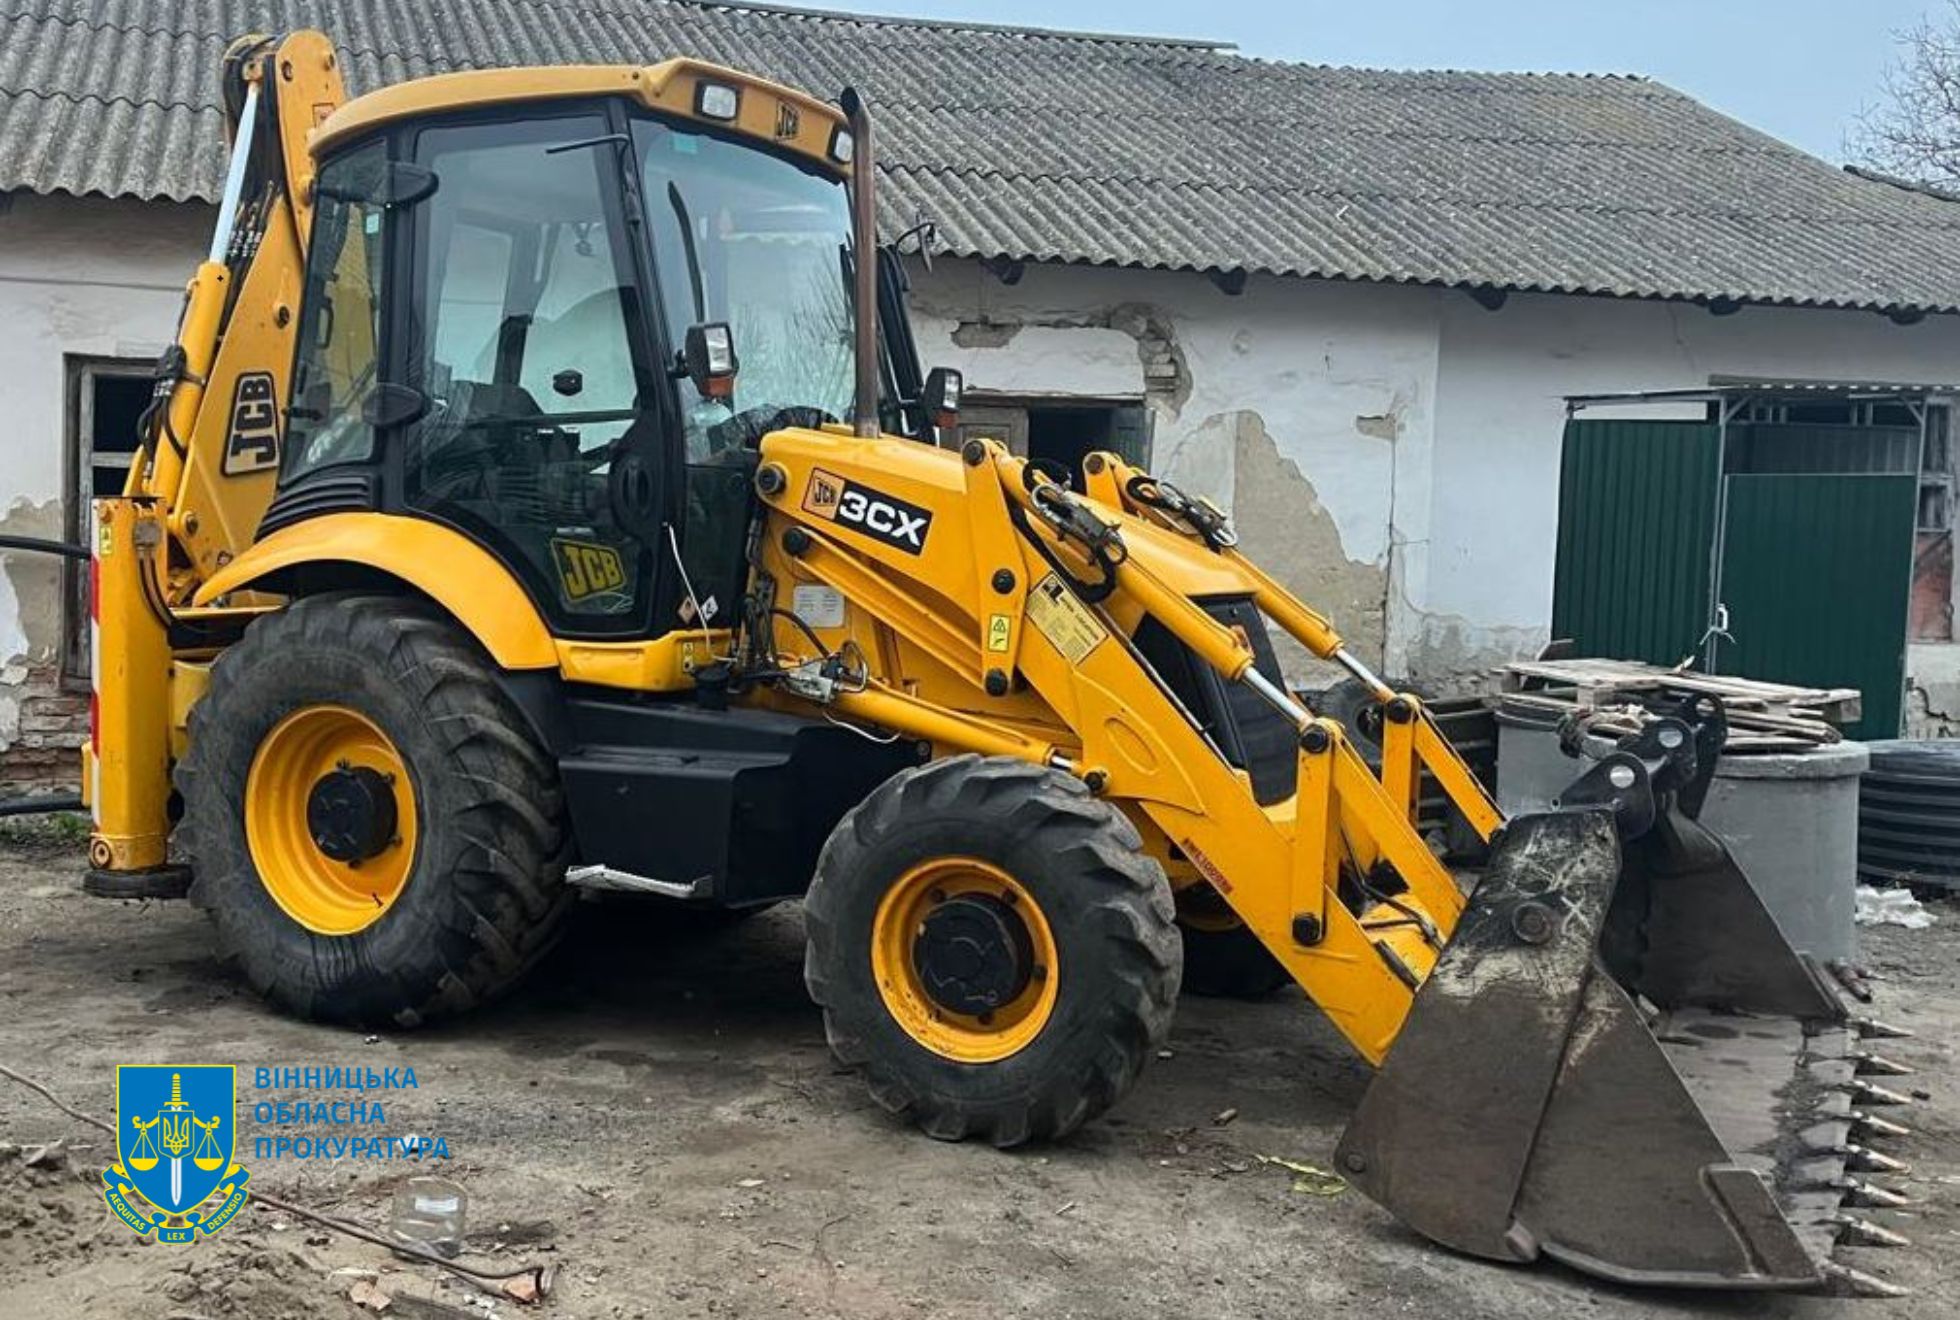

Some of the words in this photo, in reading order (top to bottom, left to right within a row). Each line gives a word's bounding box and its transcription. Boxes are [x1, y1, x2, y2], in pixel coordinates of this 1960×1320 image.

[230, 378, 277, 465] JCB
[839, 490, 927, 547] 3CX
[563, 544, 623, 597] JCB
